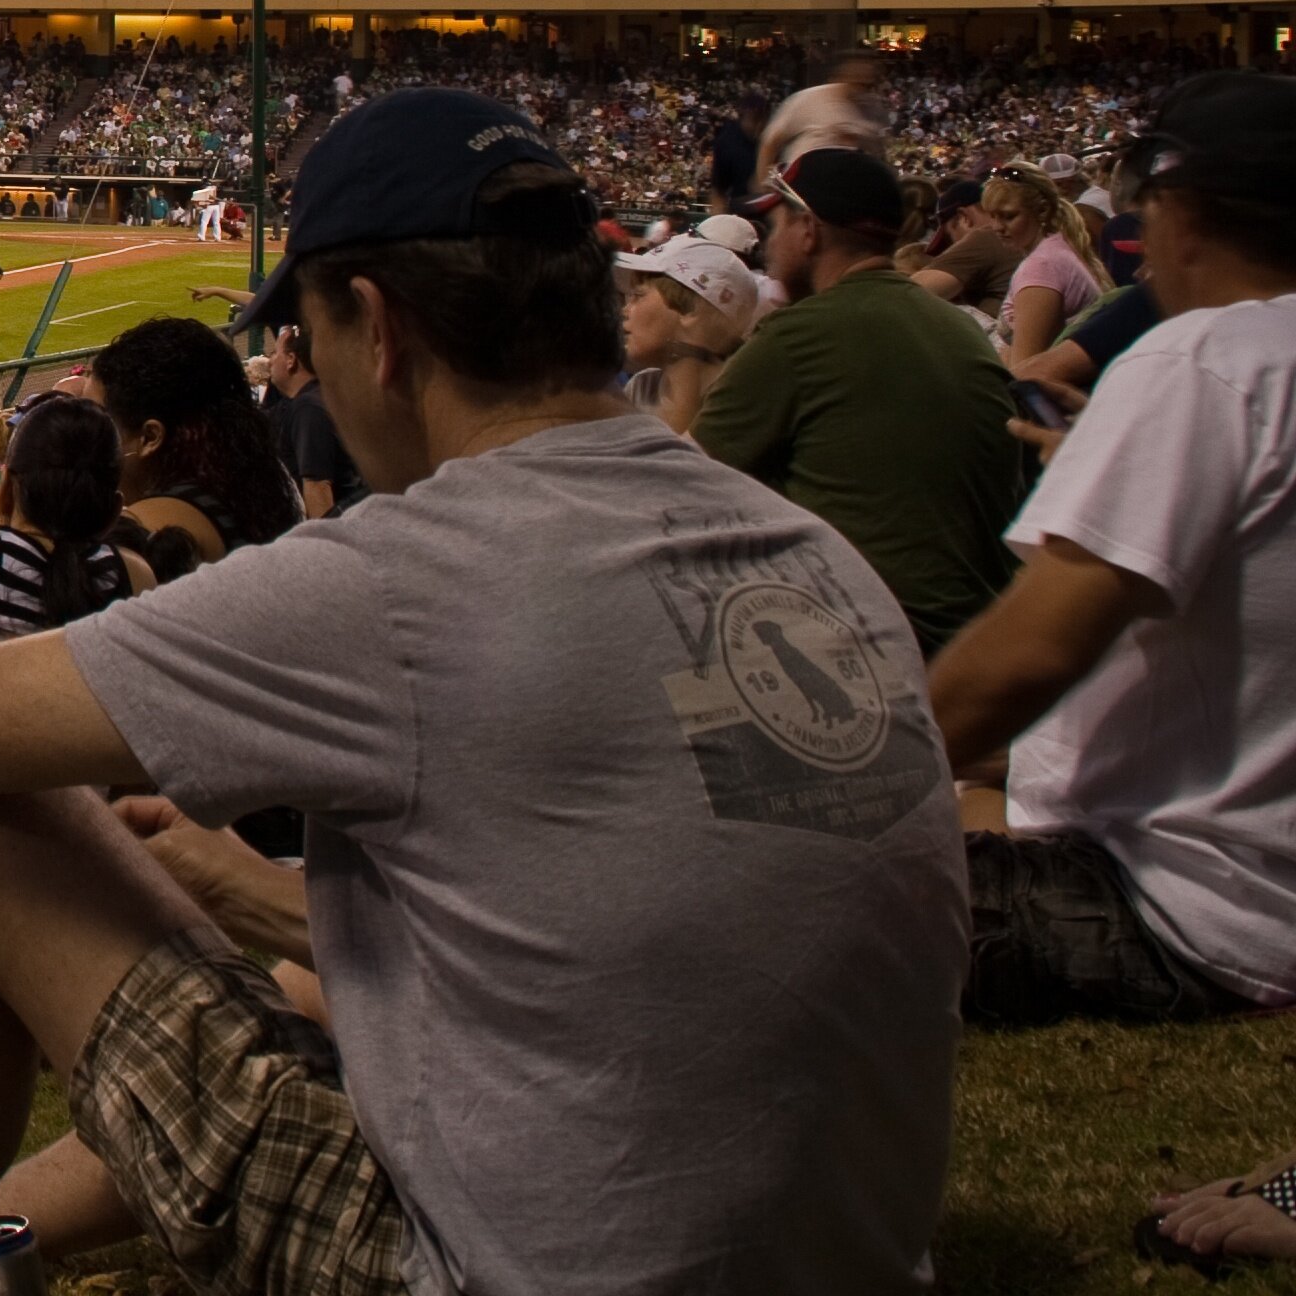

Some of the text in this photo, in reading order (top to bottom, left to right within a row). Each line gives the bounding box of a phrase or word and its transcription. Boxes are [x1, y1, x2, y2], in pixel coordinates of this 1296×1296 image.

[466, 125, 504, 152] GOOD
[836, 658, 864, 681] 60
[745, 669, 780, 695] 19
[769, 792, 795, 813] THE
